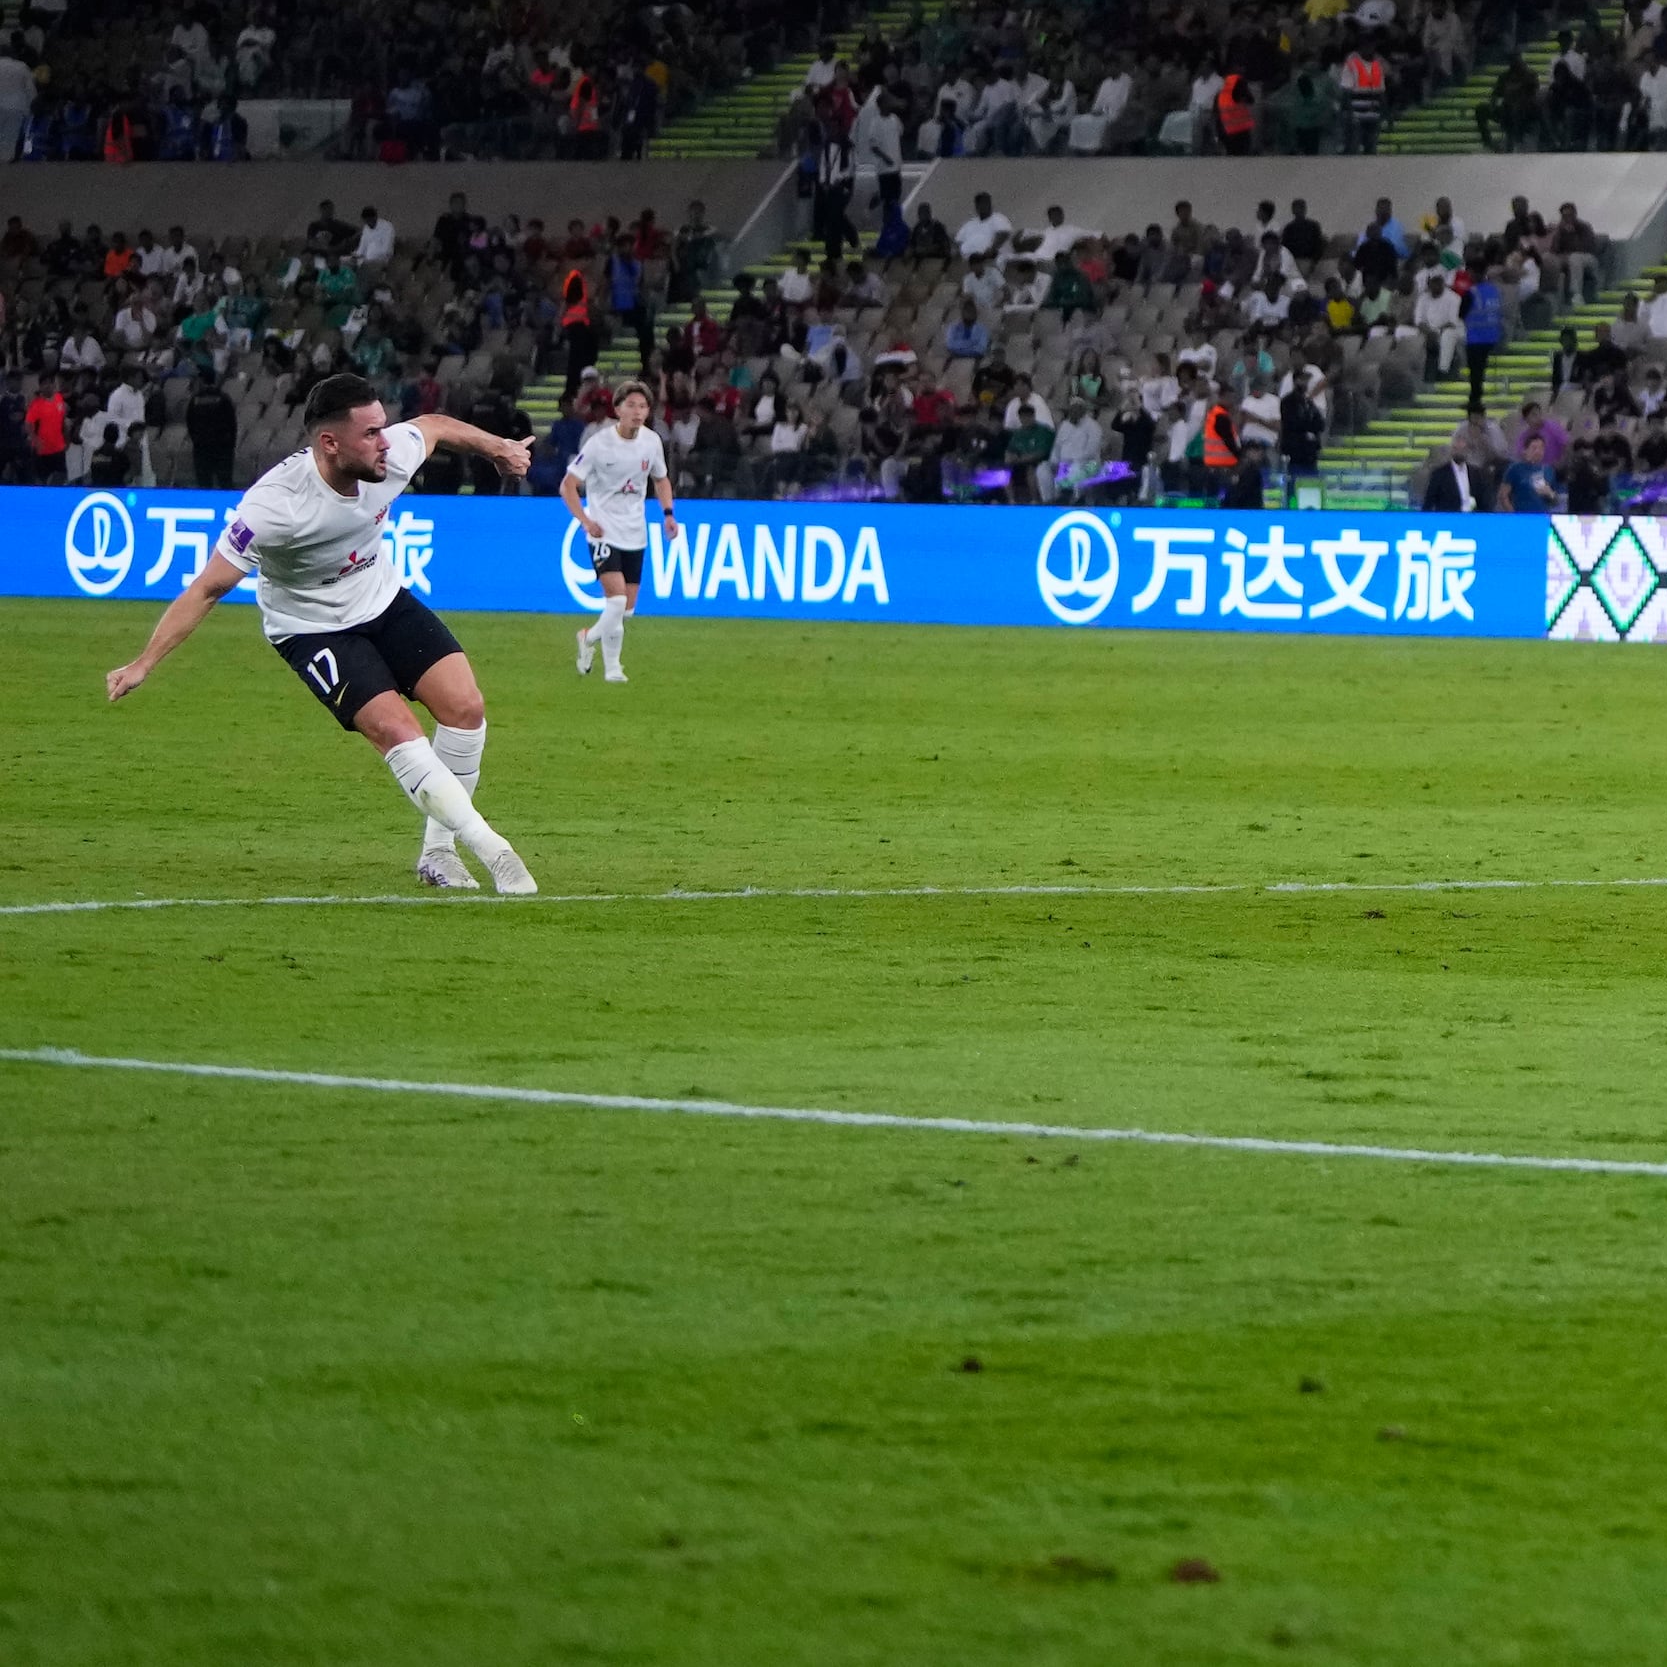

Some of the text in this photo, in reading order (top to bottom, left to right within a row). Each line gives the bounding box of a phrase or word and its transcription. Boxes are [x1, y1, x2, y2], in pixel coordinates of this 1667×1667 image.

[592, 540, 611, 561] 26
[648, 522, 889, 604] WANDA
[1131, 525, 1478, 623] 万达文旅
[307, 648, 339, 694] 17
